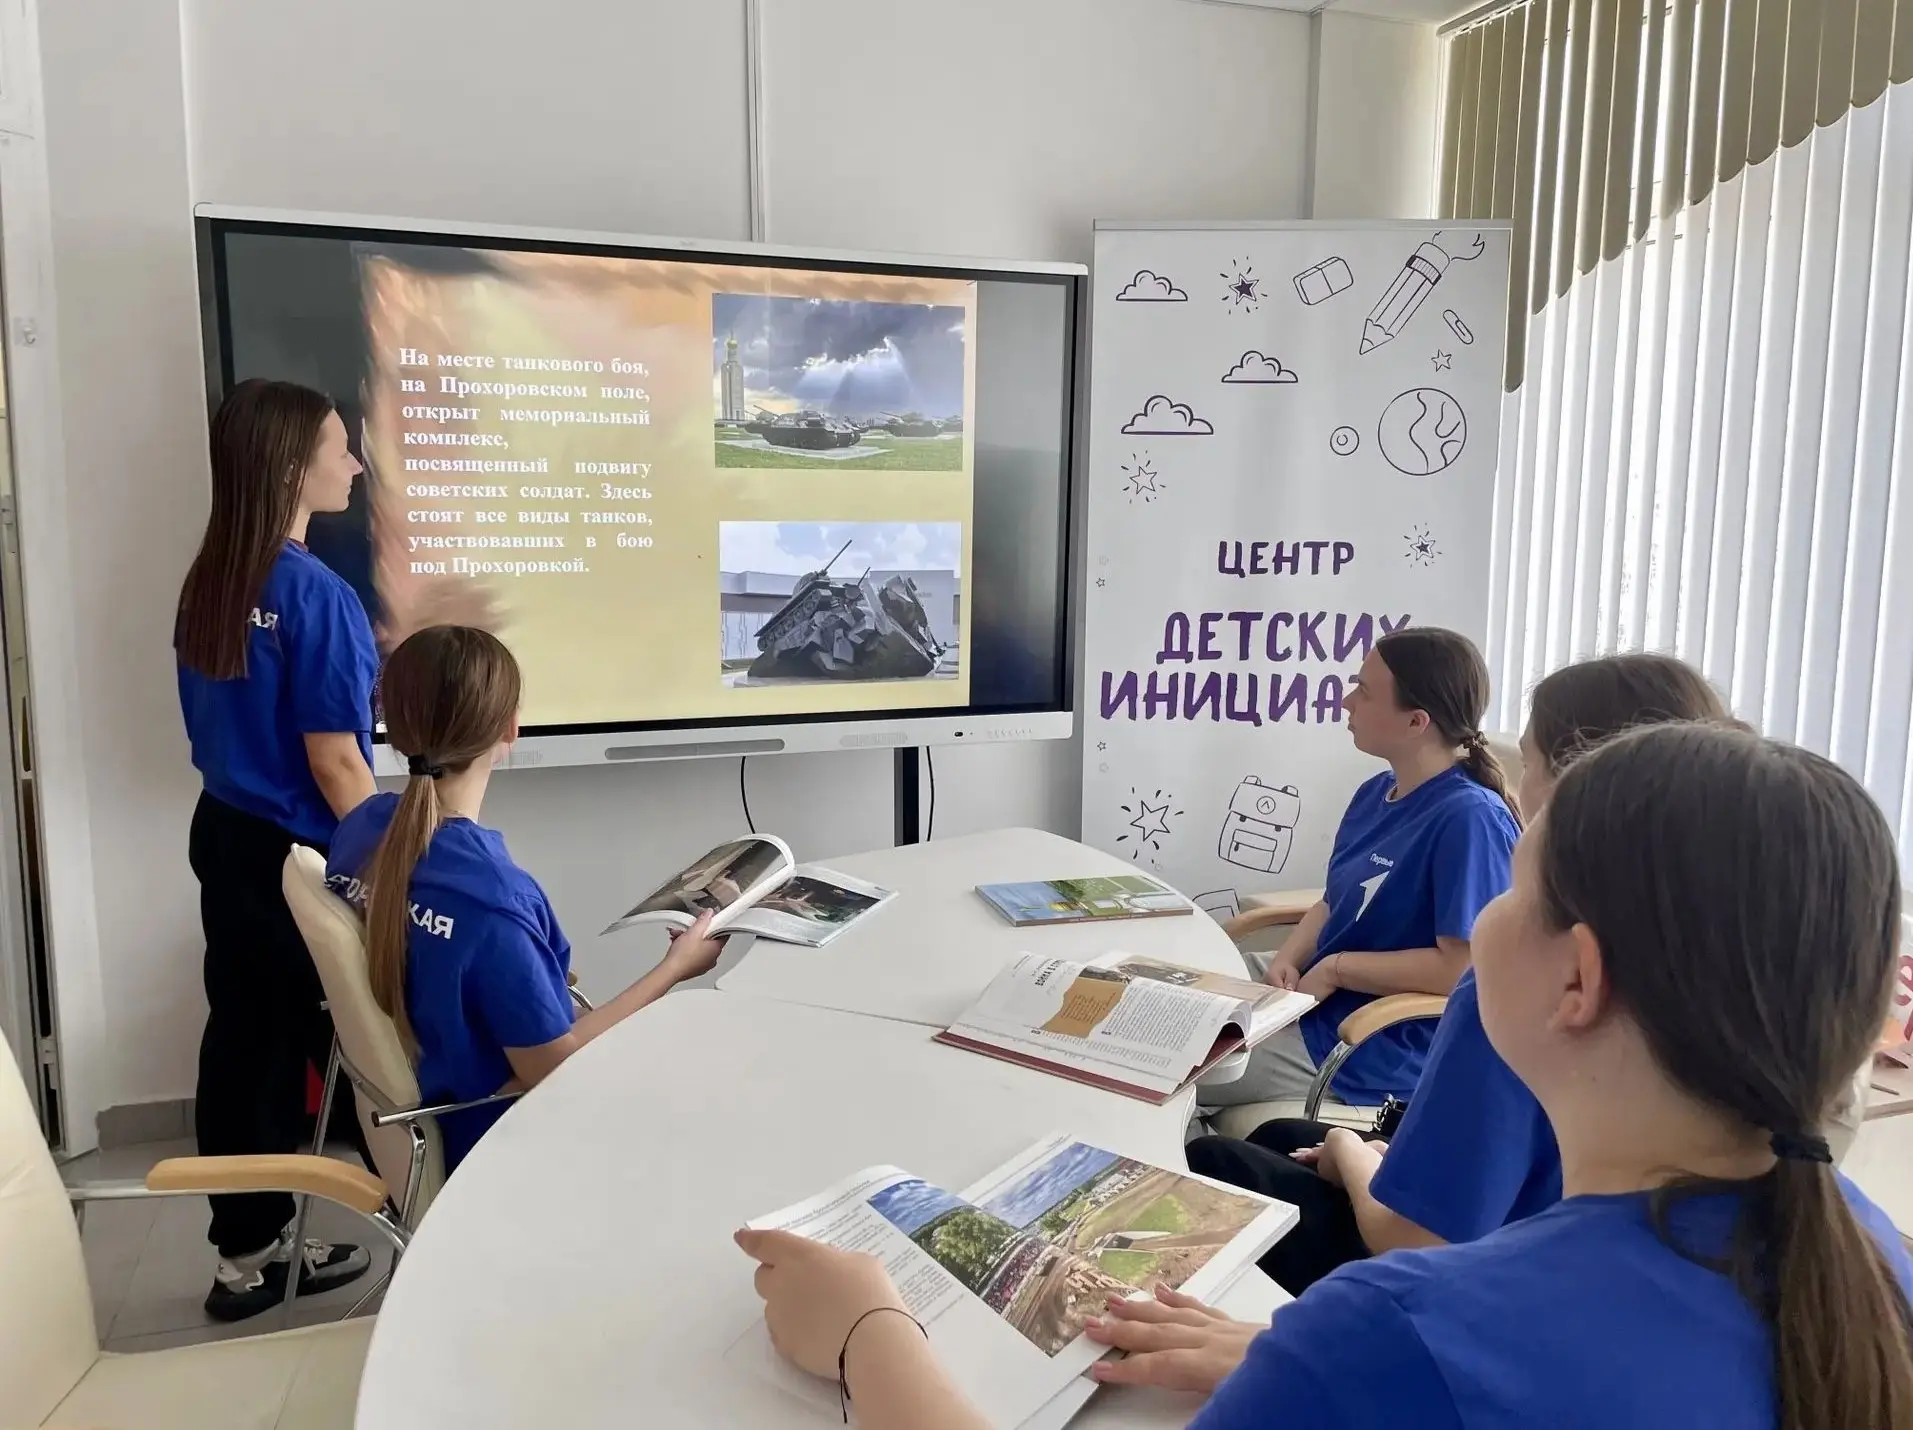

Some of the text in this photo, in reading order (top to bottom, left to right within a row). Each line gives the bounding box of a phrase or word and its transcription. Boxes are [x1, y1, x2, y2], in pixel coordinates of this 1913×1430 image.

[400, 347, 650, 378] На месте танкового боя,
[400, 376, 651, 403] на Прохоровском поле,
[402, 405, 651, 427] открыт мемориальный
[403, 430, 510, 450] комплекс,
[404, 457, 652, 478] посвященный подвигу
[406, 481, 653, 501] советских солдат. Здесь
[407, 508, 653, 526] стоят все виды танков,
[408, 532, 654, 553] участвовавших в бою
[409, 556, 591, 578] под Прохоровкой.
[1218, 540, 1355, 578] ЦЕНТР
[247, 607, 279, 631] АЯ
[1100, 671, 1359, 727] ИНИЦИА
